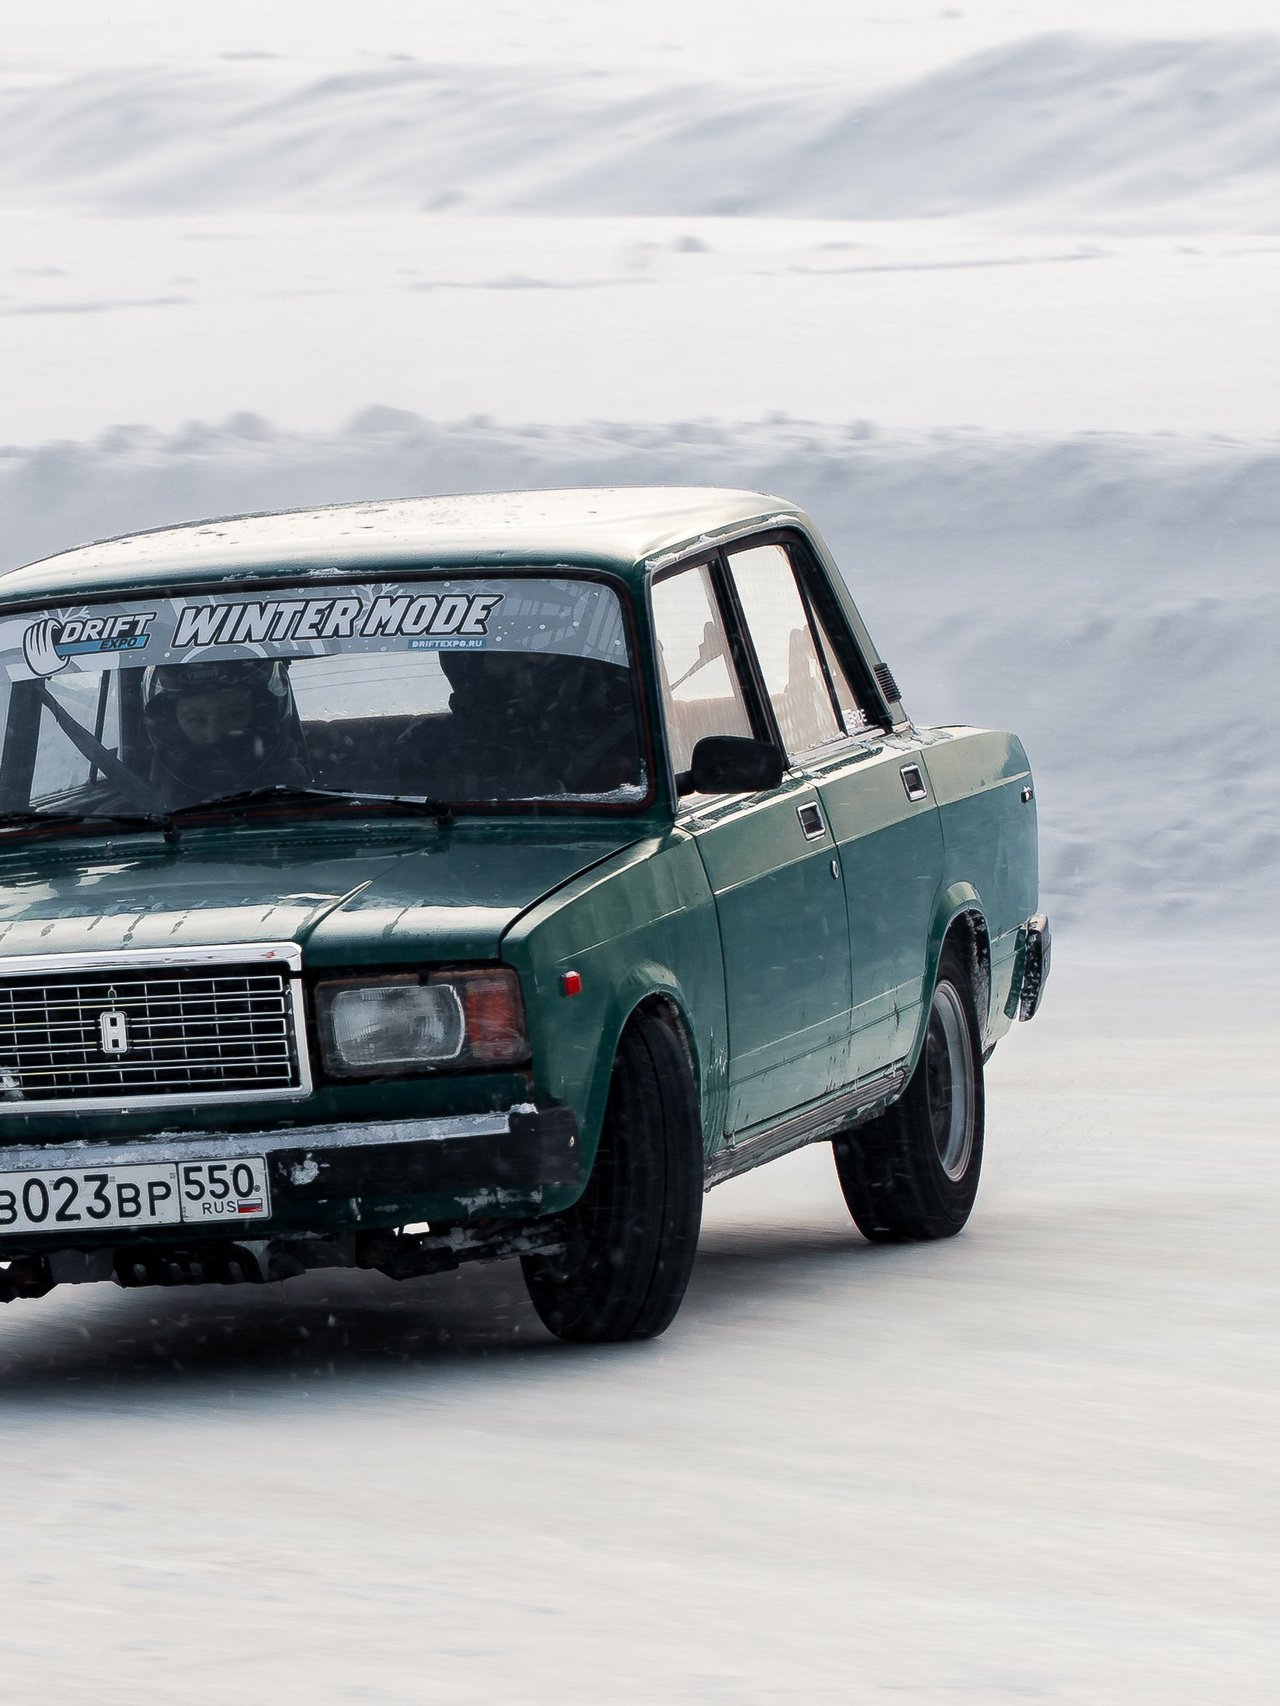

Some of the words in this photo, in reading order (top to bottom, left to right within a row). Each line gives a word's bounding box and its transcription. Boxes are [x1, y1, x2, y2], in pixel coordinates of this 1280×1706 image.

[59, 613, 155, 644] DRIFT
[171, 597, 364, 647] WINTER
[359, 594, 503, 637] MODE
[99, 637, 139, 651] EXPO
[411, 639, 484, 649] DRIFTEXPO.RU
[184, 1163, 255, 1201] 550
[202, 1200, 238, 1215] RUS
